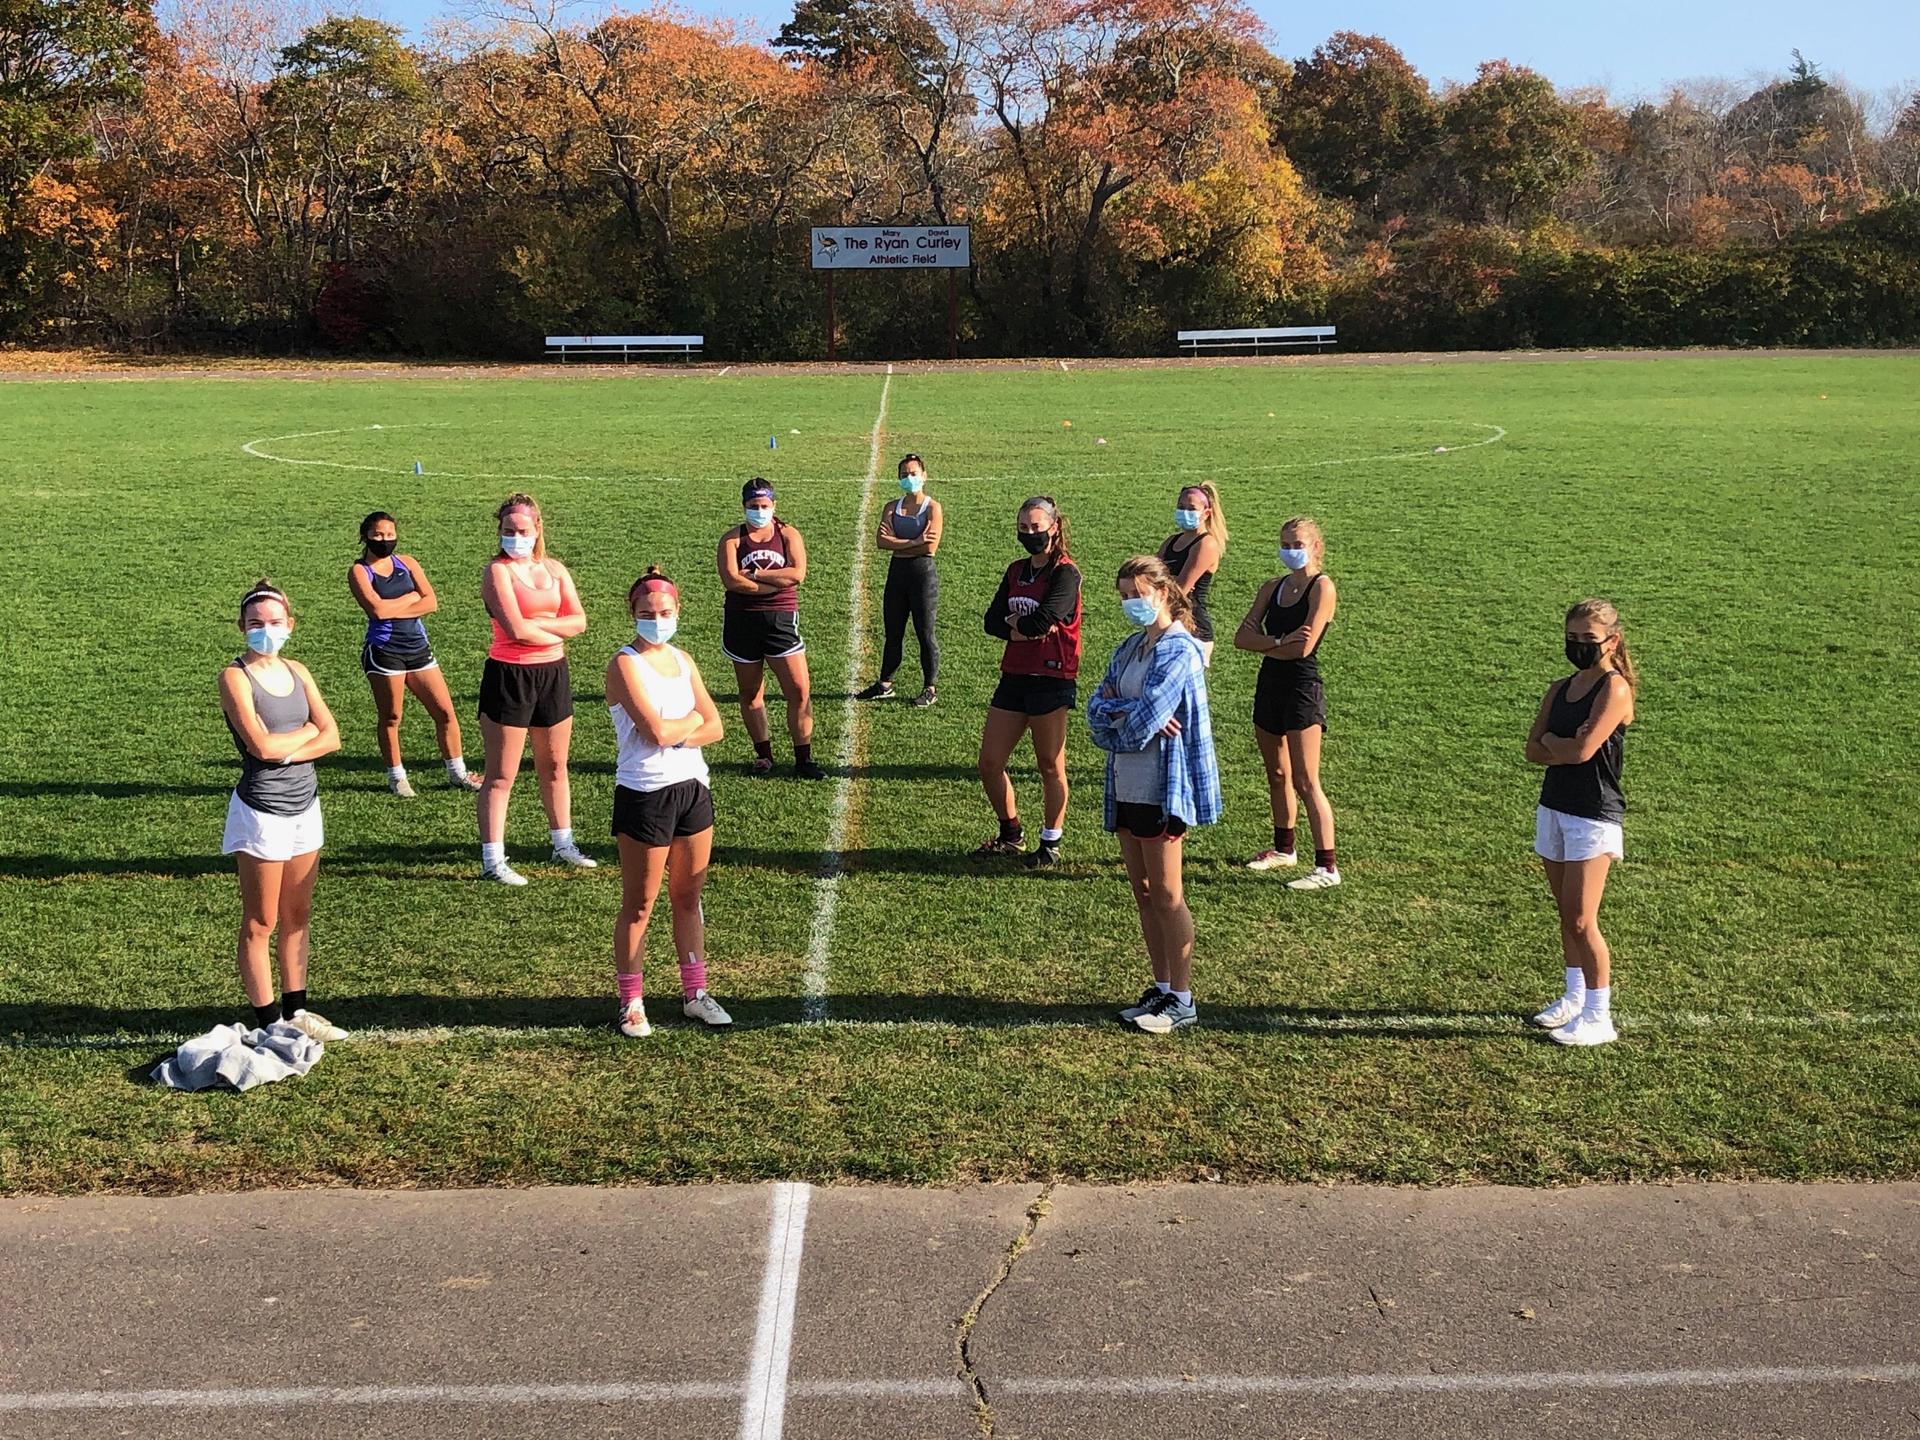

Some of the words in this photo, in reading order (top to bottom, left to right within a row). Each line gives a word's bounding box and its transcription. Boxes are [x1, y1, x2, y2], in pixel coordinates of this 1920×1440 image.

[844, 237, 868, 249] The
[875, 237, 909, 251] Ryan
[916, 236, 961, 250] Curley
[869, 254, 909, 264] Athletic
[912, 254, 937, 264] Field
